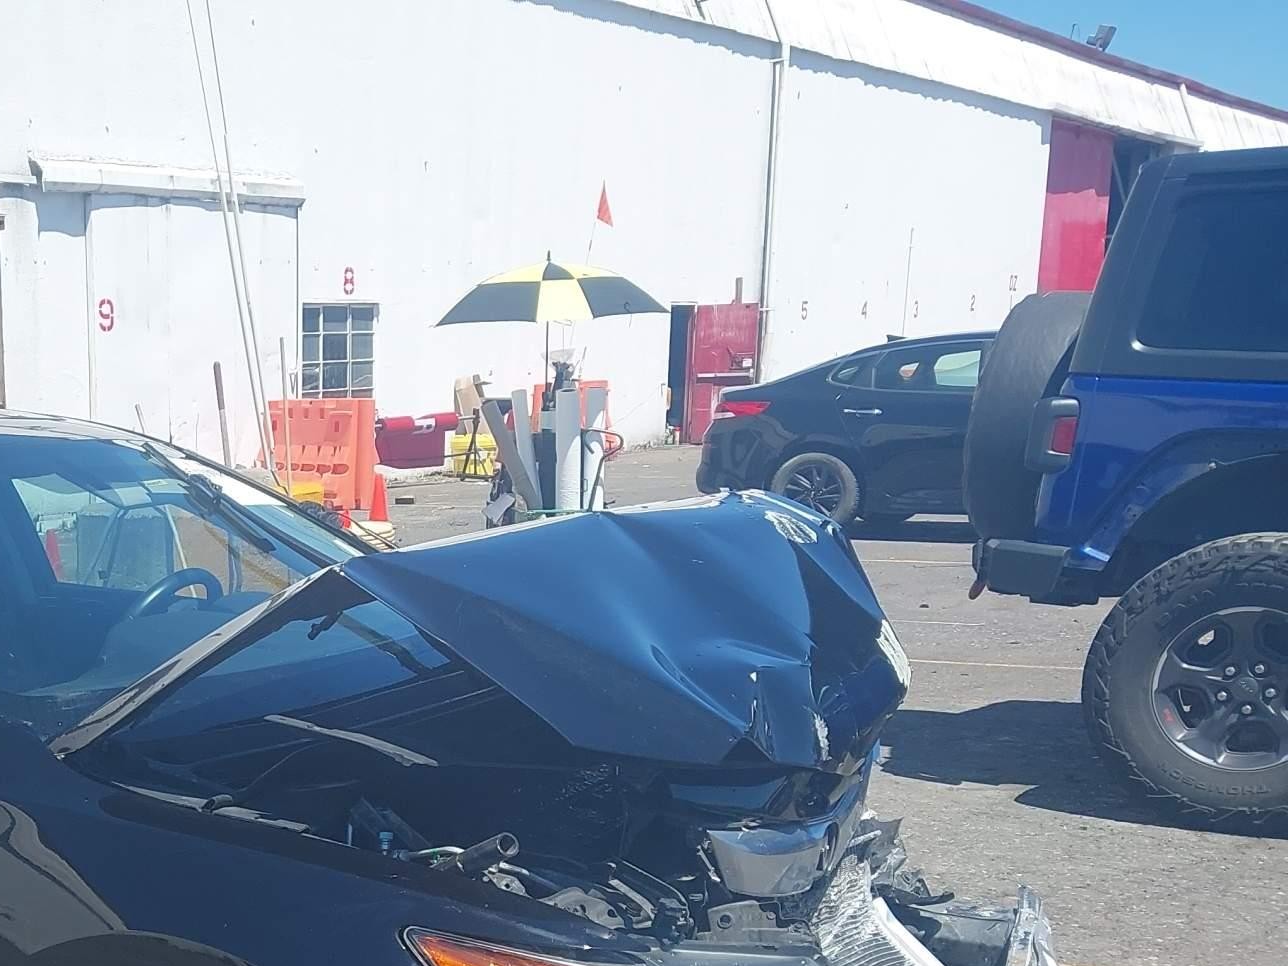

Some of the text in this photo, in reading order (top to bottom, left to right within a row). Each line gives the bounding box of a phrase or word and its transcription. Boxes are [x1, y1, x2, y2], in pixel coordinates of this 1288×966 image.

[343, 266, 355, 296] 8
[801, 300, 809, 320] 5
[861, 300, 868, 320] 4
[913, 300, 919, 318] 3
[970, 294, 976, 312] 2
[98, 298, 114, 332] 9
